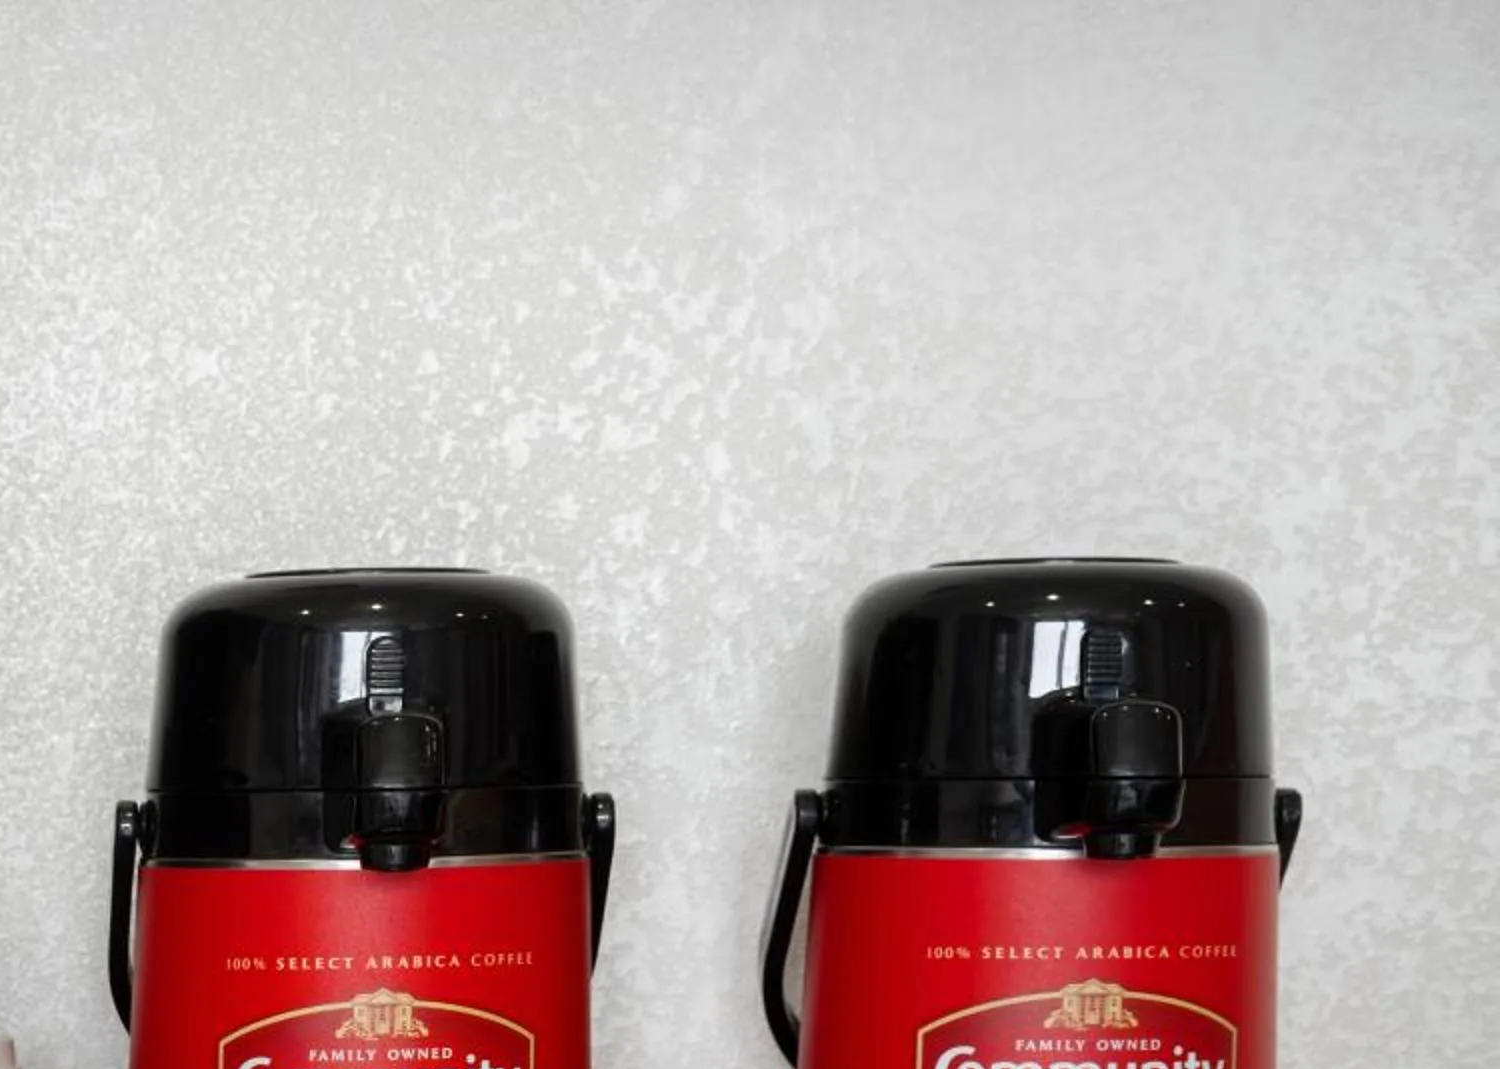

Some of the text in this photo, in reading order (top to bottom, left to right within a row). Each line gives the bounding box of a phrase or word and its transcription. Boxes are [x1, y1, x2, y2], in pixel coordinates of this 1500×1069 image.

[925, 944, 1238, 960] 100% SELECT ARABICA COFFEE
[226, 951, 534, 971] 100% SELECT ARABICA COFFEE
[1015, 1038, 1163, 1052] FAMILY OWNED
[308, 1047, 453, 1062] FAMILY OWNED
